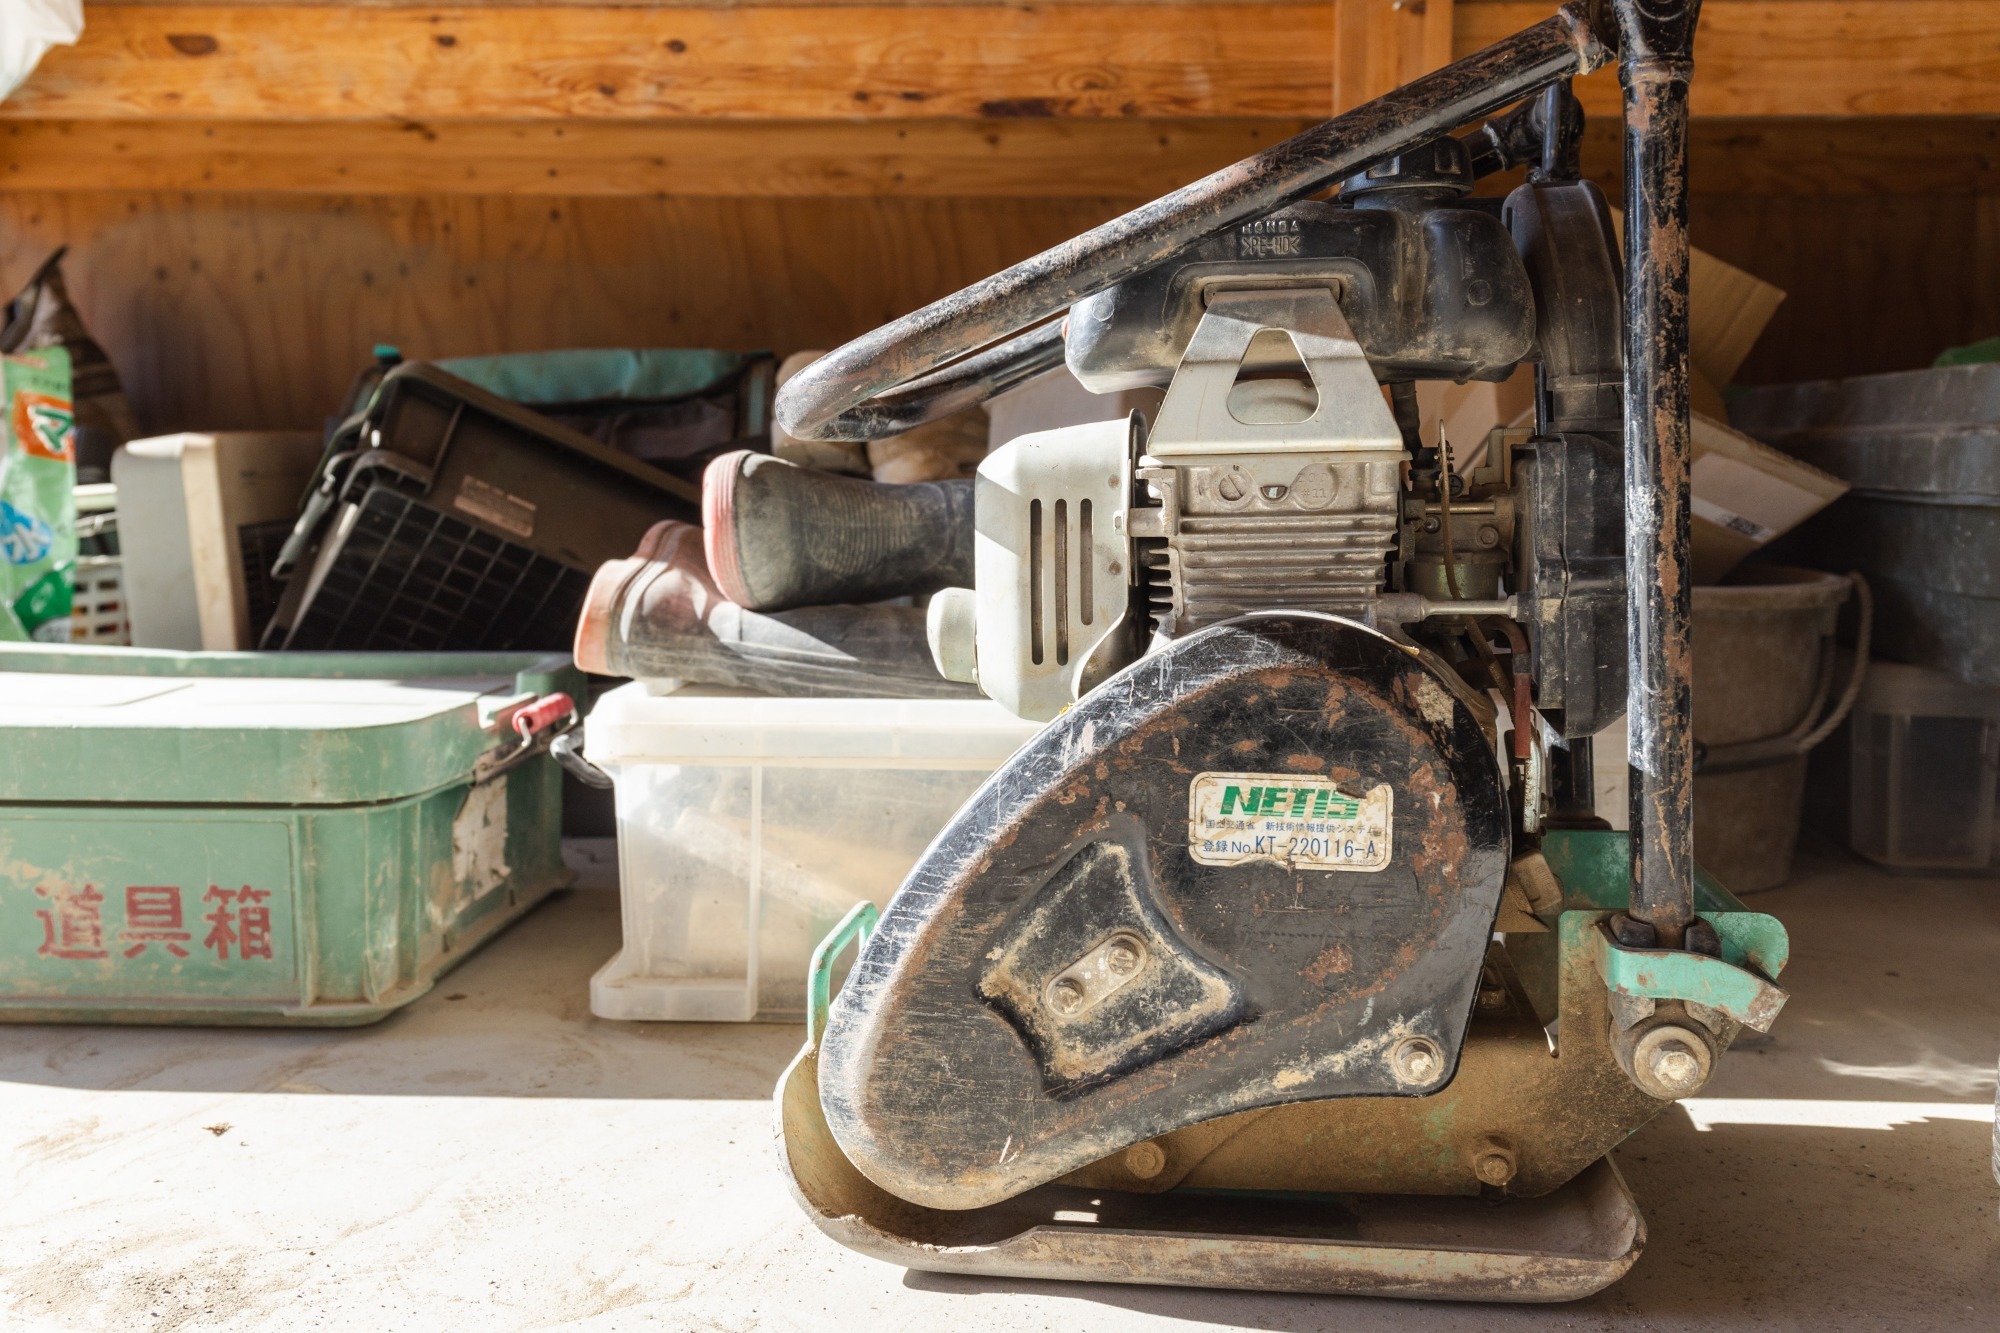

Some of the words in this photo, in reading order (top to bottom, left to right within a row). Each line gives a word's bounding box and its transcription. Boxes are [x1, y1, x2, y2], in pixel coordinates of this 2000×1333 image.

[1242, 220, 1300, 234] HONDA
[1219, 785, 1360, 820] NETIS
[34, 883, 273, 960] 道具箱
